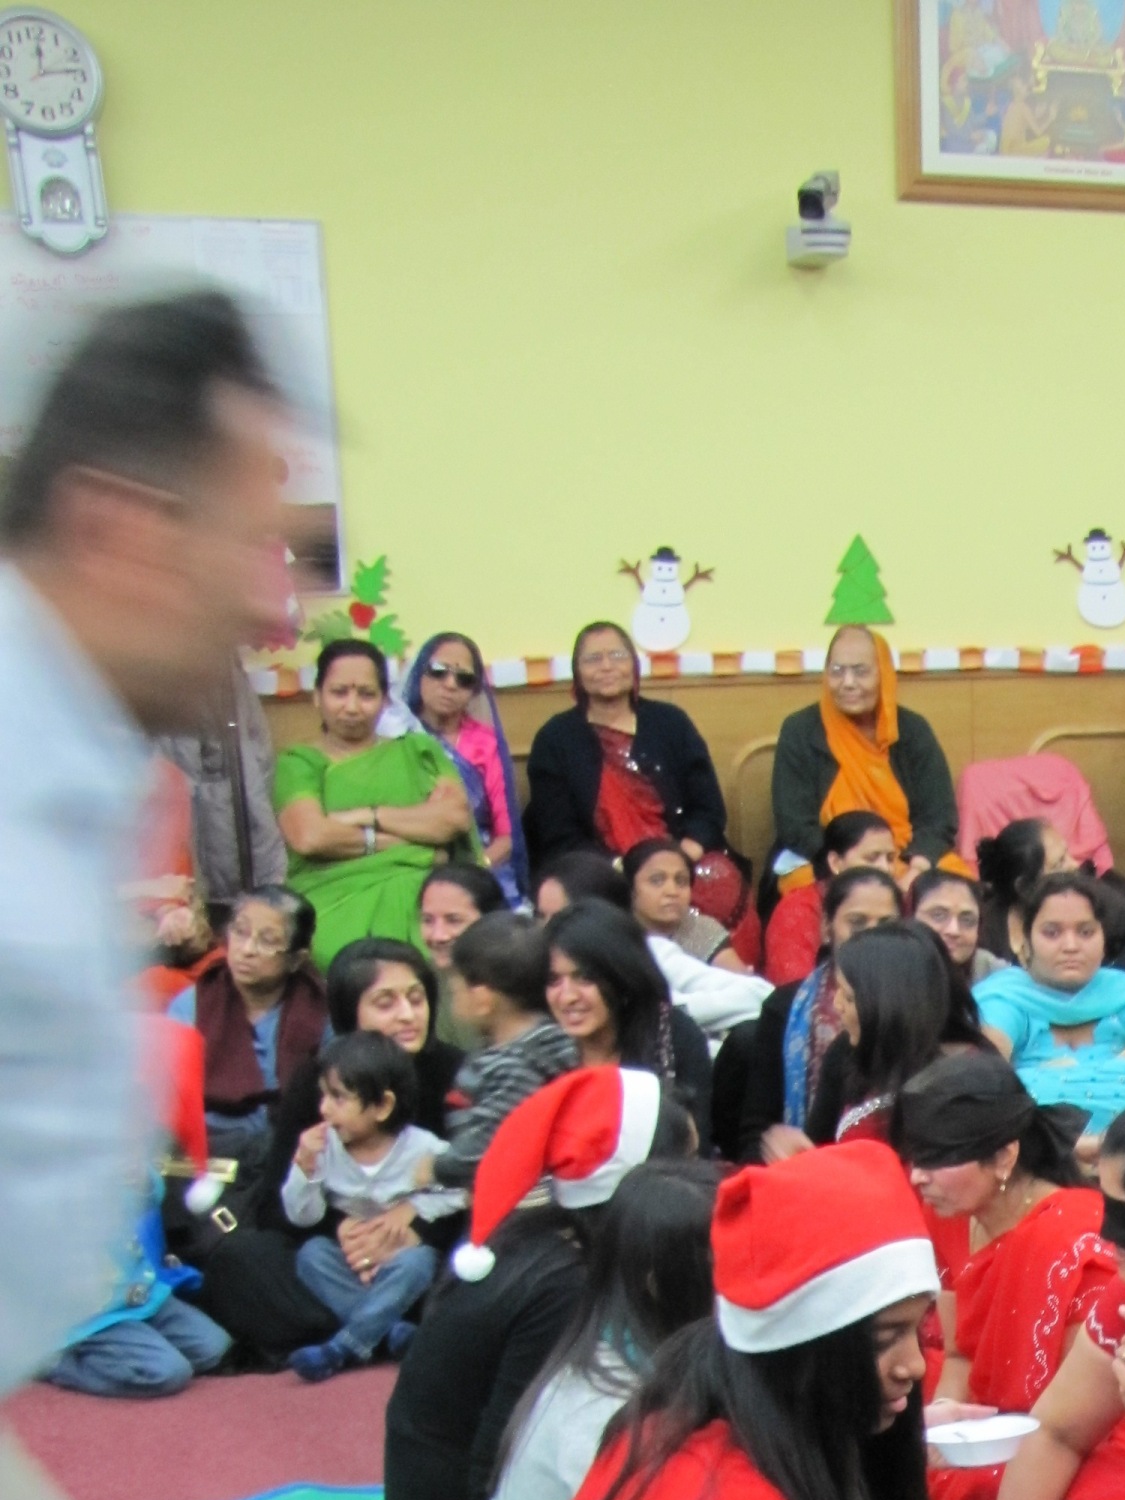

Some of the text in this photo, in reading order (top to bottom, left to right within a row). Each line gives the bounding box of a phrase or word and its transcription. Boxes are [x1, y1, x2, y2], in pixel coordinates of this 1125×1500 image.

[7, 30, 22, 44] 11
[25, 26, 45, 42] 12
[54, 33, 59, 47] 1
[0, 46, 13, 59] 0
[64, 47, 80, 63] 2
[73, 68, 87, 84] 3
[3, 83, 19, 99] 8
[70, 87, 83, 102] 4
[20, 101, 34, 115] 7
[41, 105, 56, 121] 6
[60, 102, 74, 117] 5
